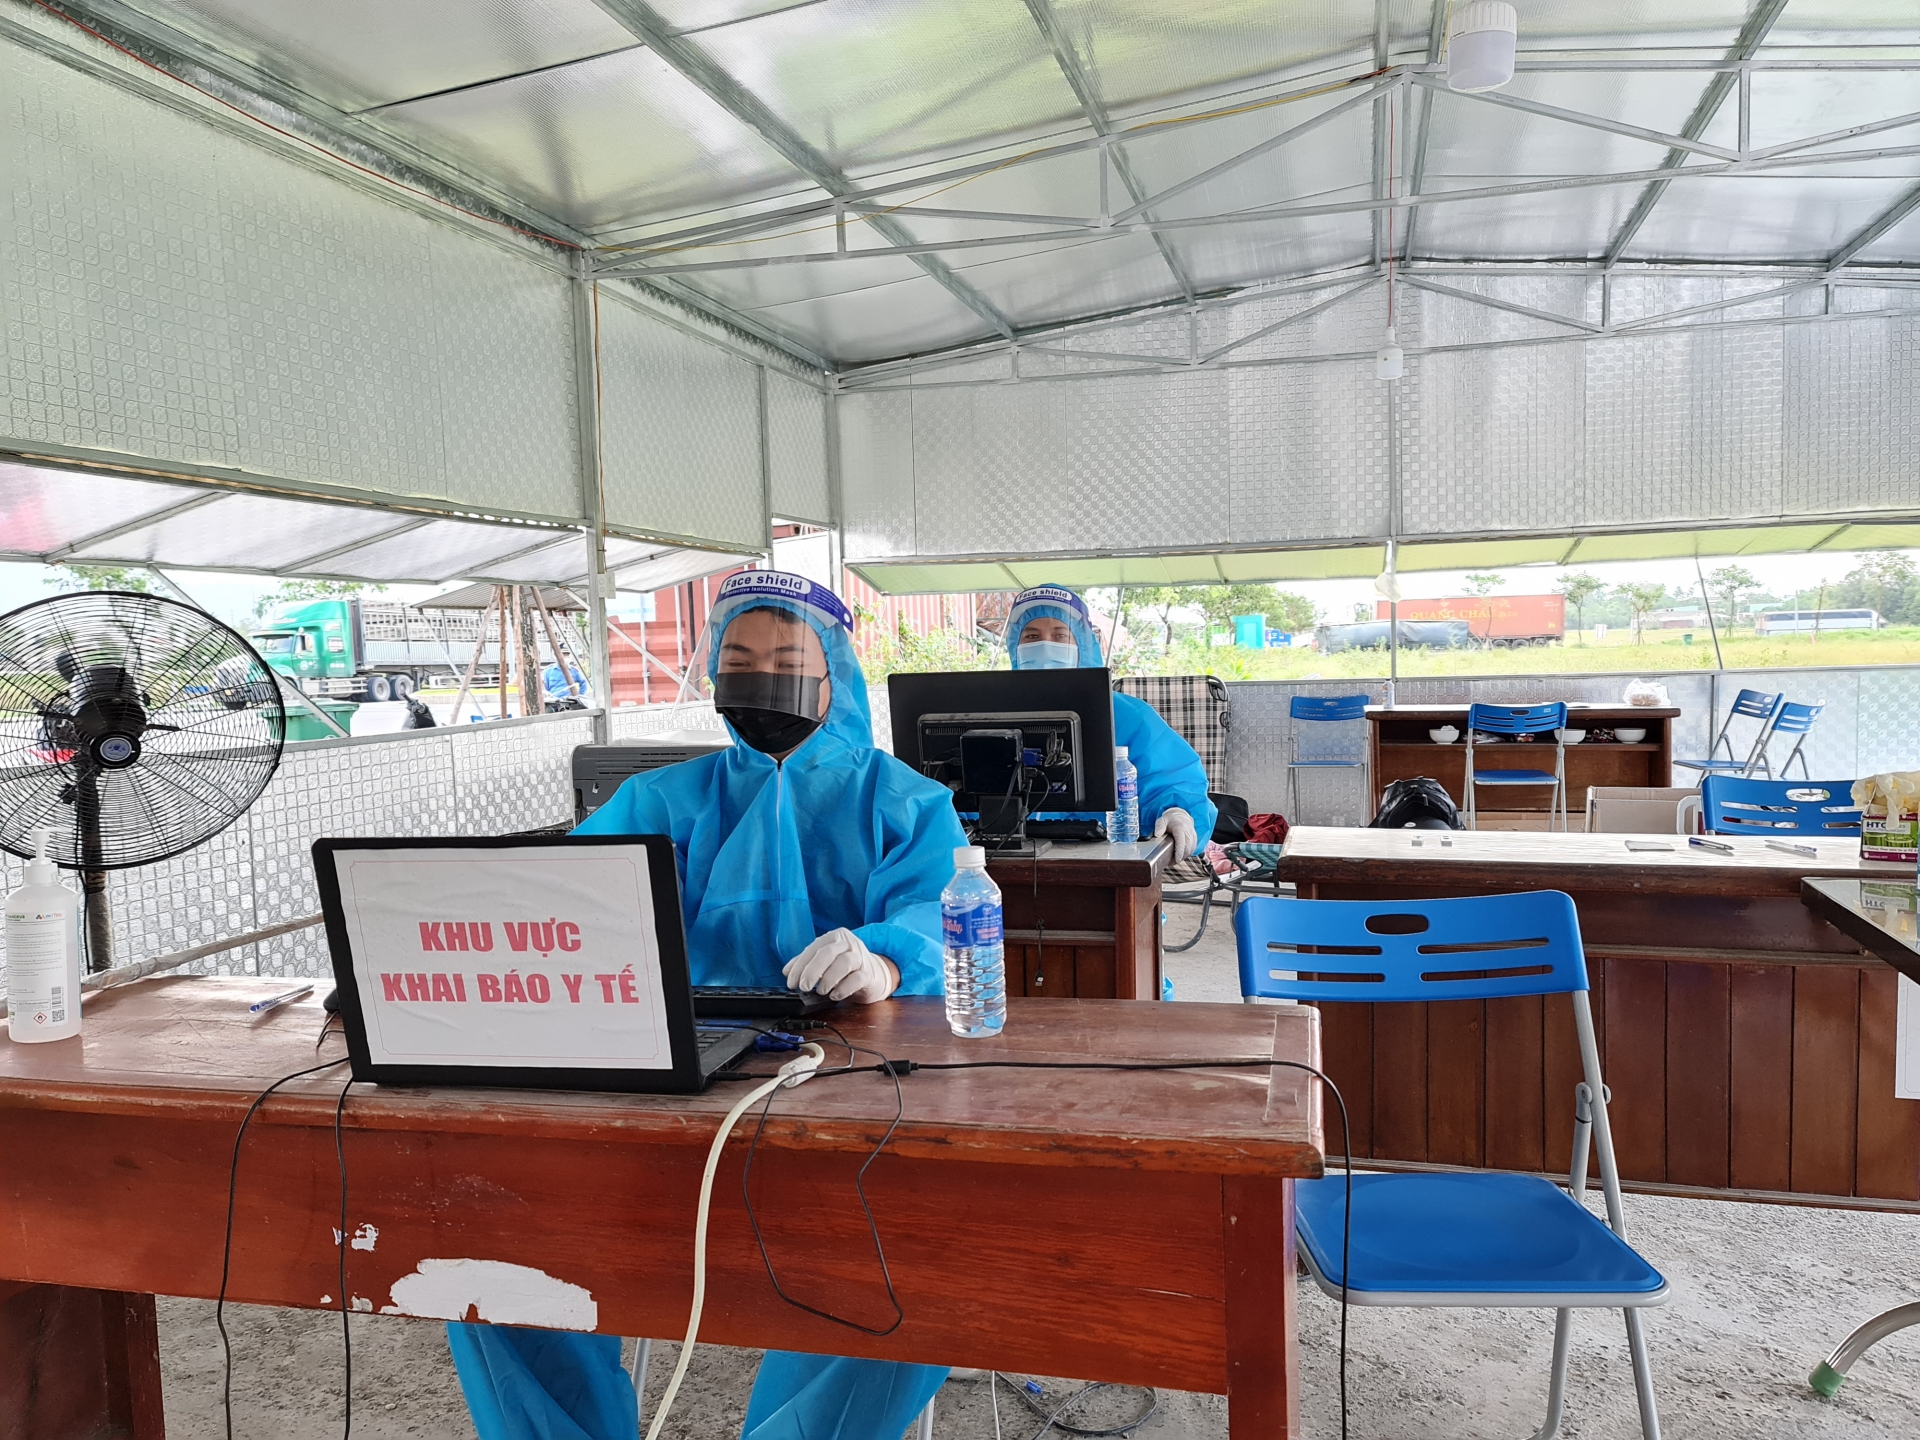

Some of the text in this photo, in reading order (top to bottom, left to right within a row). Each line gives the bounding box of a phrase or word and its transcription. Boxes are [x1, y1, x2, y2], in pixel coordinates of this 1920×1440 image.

[724, 574, 803, 591] Face shield
[751, 586, 778, 594] Isolution
[780, 588, 797, 598] Mask
[1019, 590, 1037, 600] Face
[1039, 588, 1068, 599] shield
[418, 917, 582, 957] KHU VỰC
[380, 963, 639, 1004] KHAI BÁO Y TẾ
